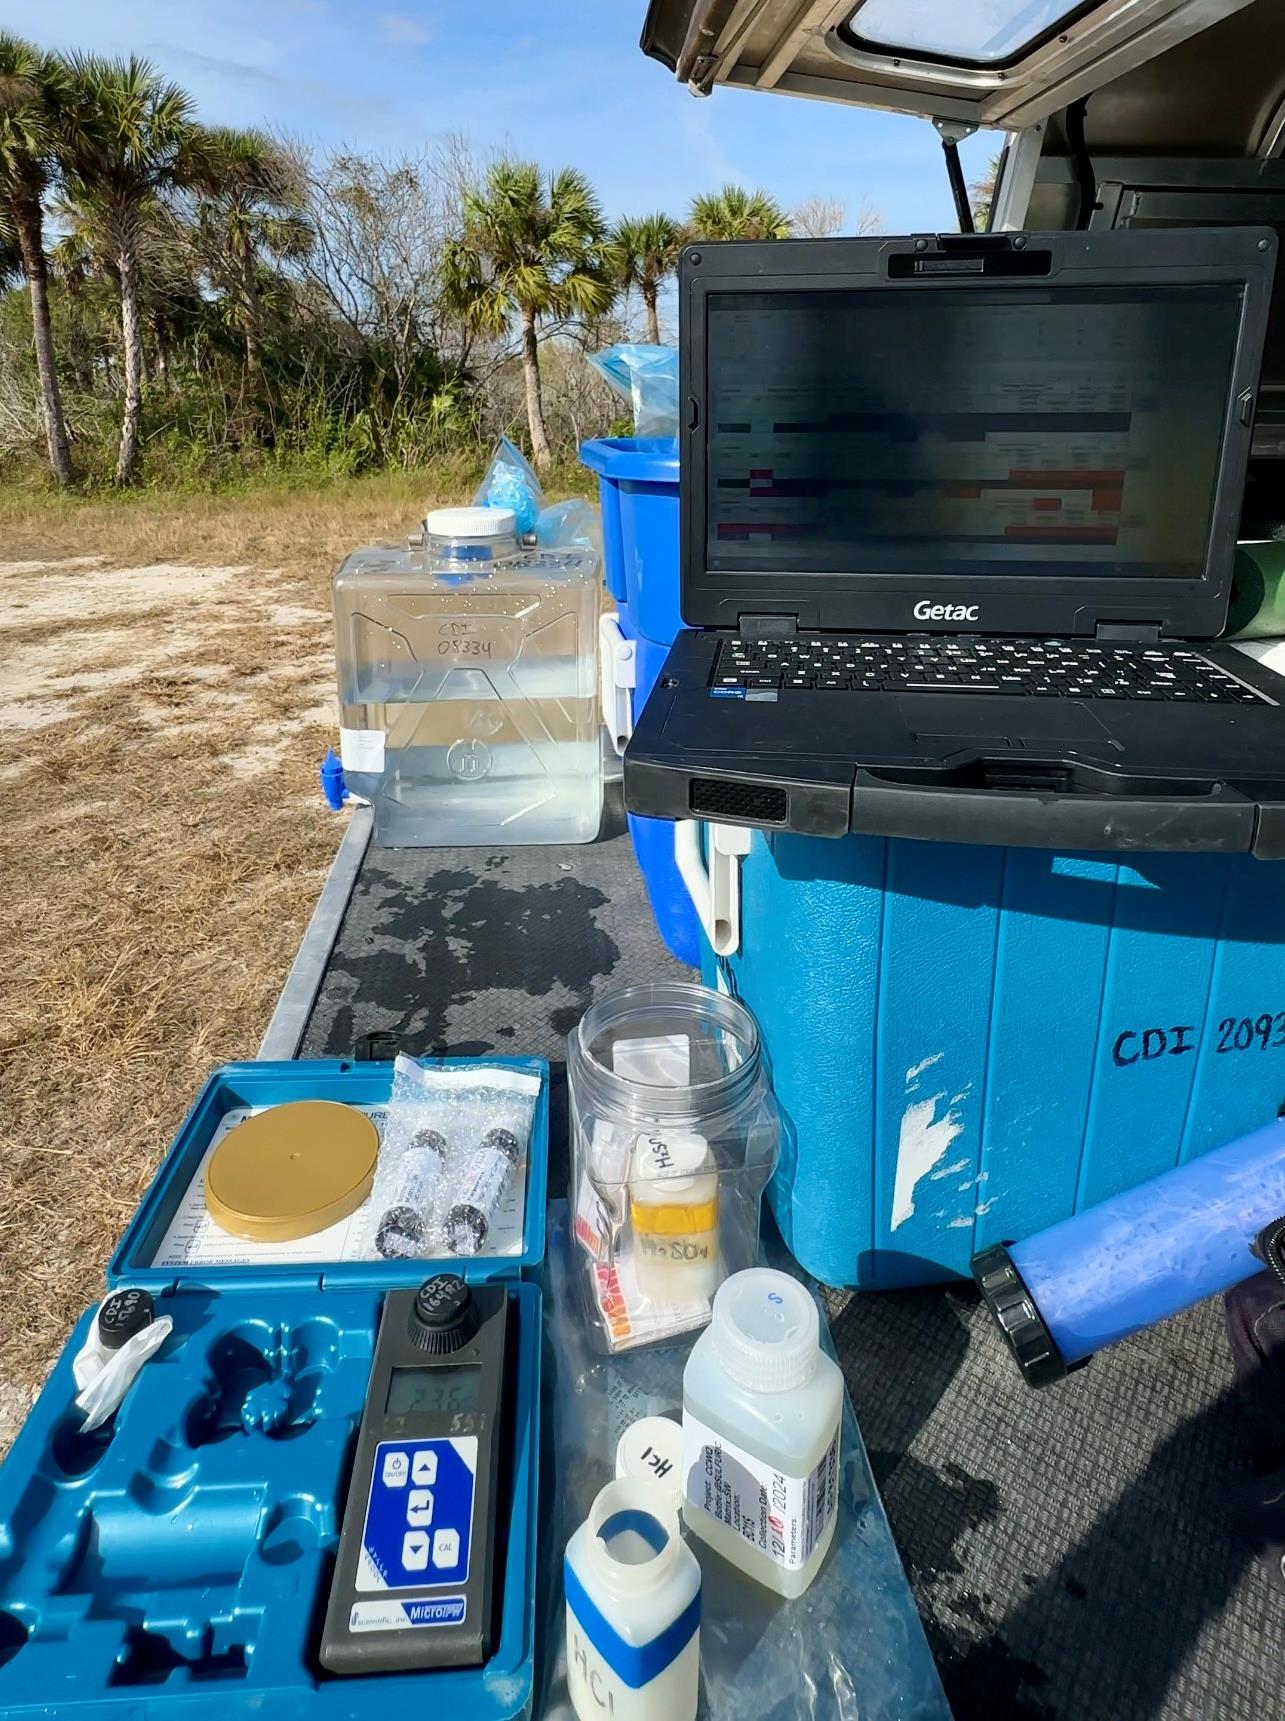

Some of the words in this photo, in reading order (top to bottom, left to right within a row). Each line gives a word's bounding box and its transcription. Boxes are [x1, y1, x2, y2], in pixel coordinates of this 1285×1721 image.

[913, 600, 980, 621] Getac
[438, 622, 477, 636] CDI
[1112, 1025, 1196, 1068] CDI
[1216, 1012, 1285, 1053] 2093
[420, 1277, 449, 1299] CDI
[104, 1298, 122, 1324] CDI
[439, 1542, 453, 1552] CAL
